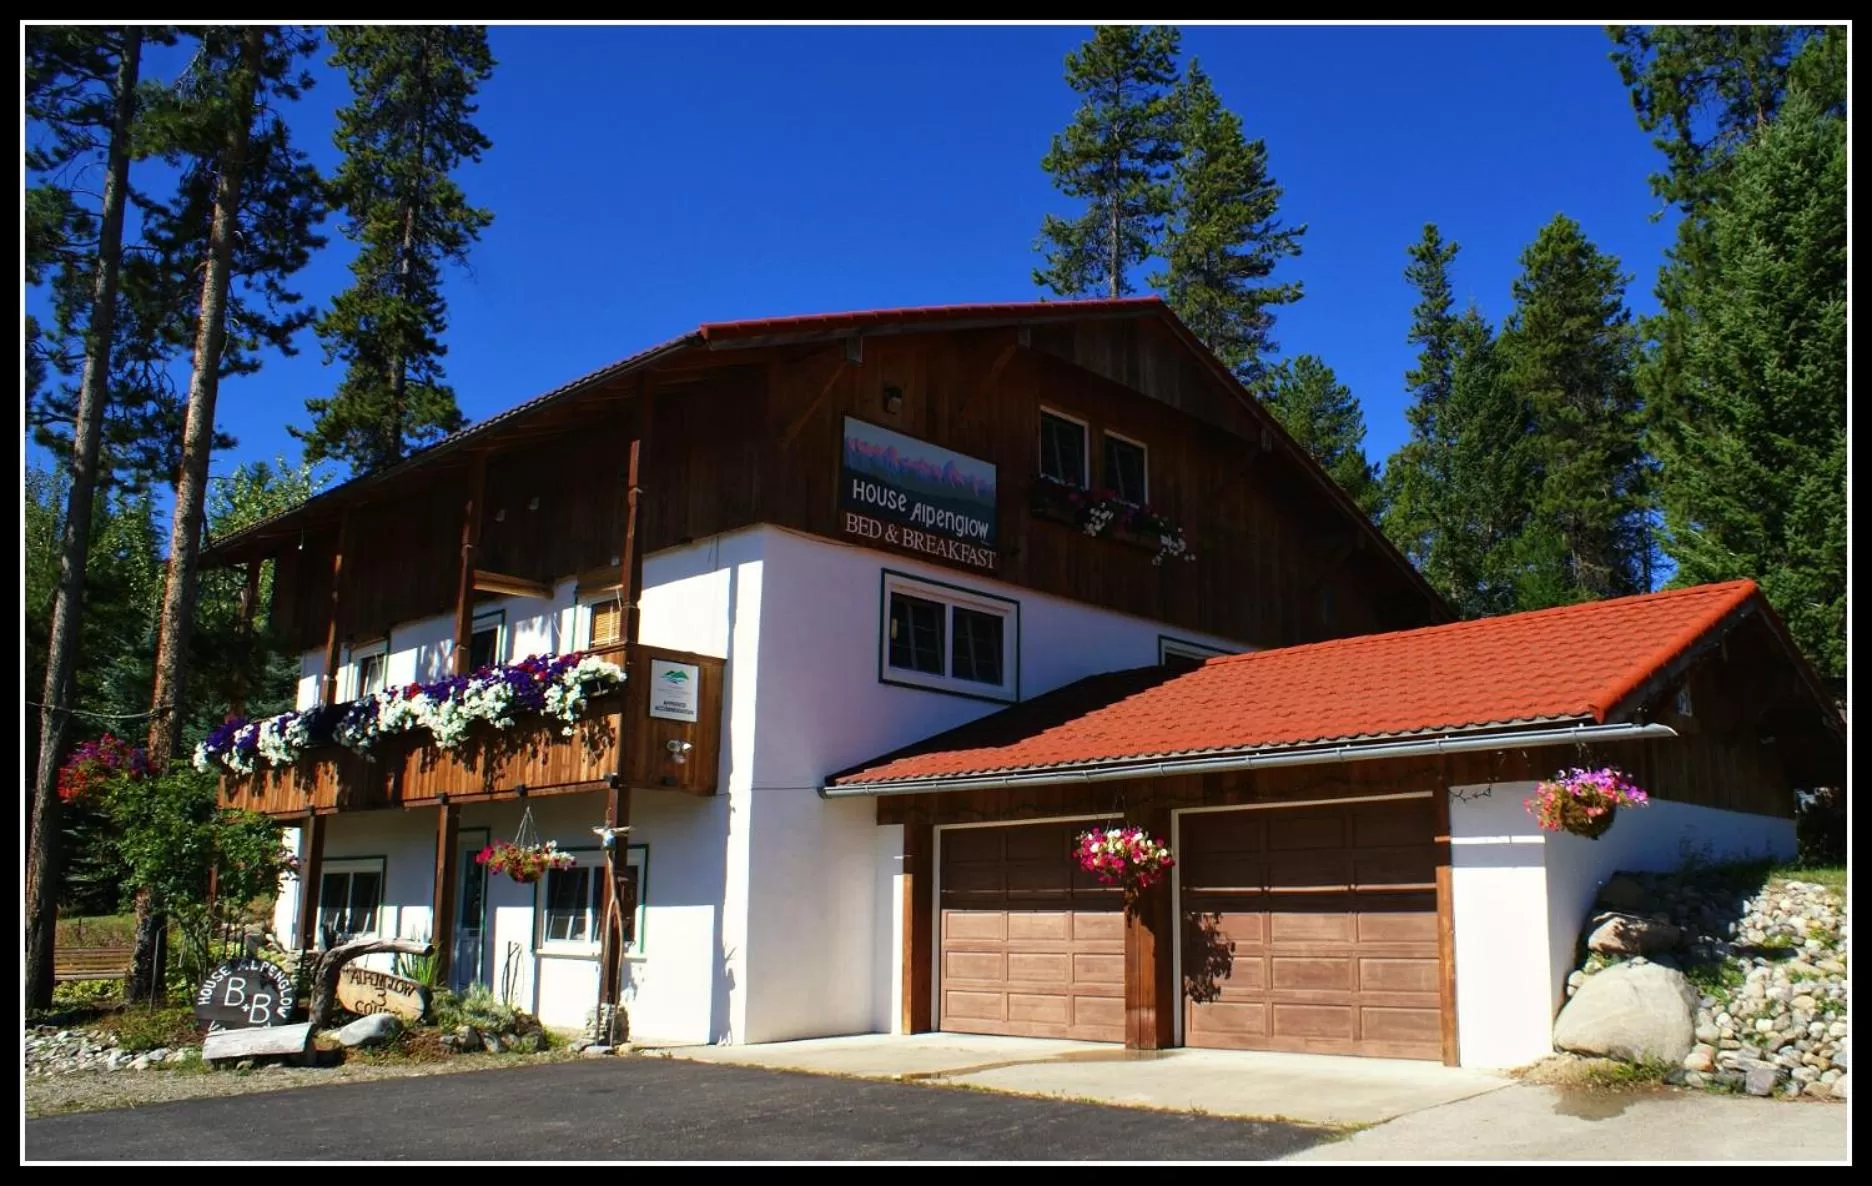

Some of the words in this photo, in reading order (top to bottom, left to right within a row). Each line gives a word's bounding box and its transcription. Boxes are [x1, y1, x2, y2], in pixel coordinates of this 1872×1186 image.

[910, 502, 989, 539] Alpenglow
[846, 512, 882, 539] BED
[885, 524, 899, 545] &
[903, 527, 997, 569] BREAKFAST
[198, 965, 232, 1006] HOUSE
[371, 987, 387, 1006] 3
